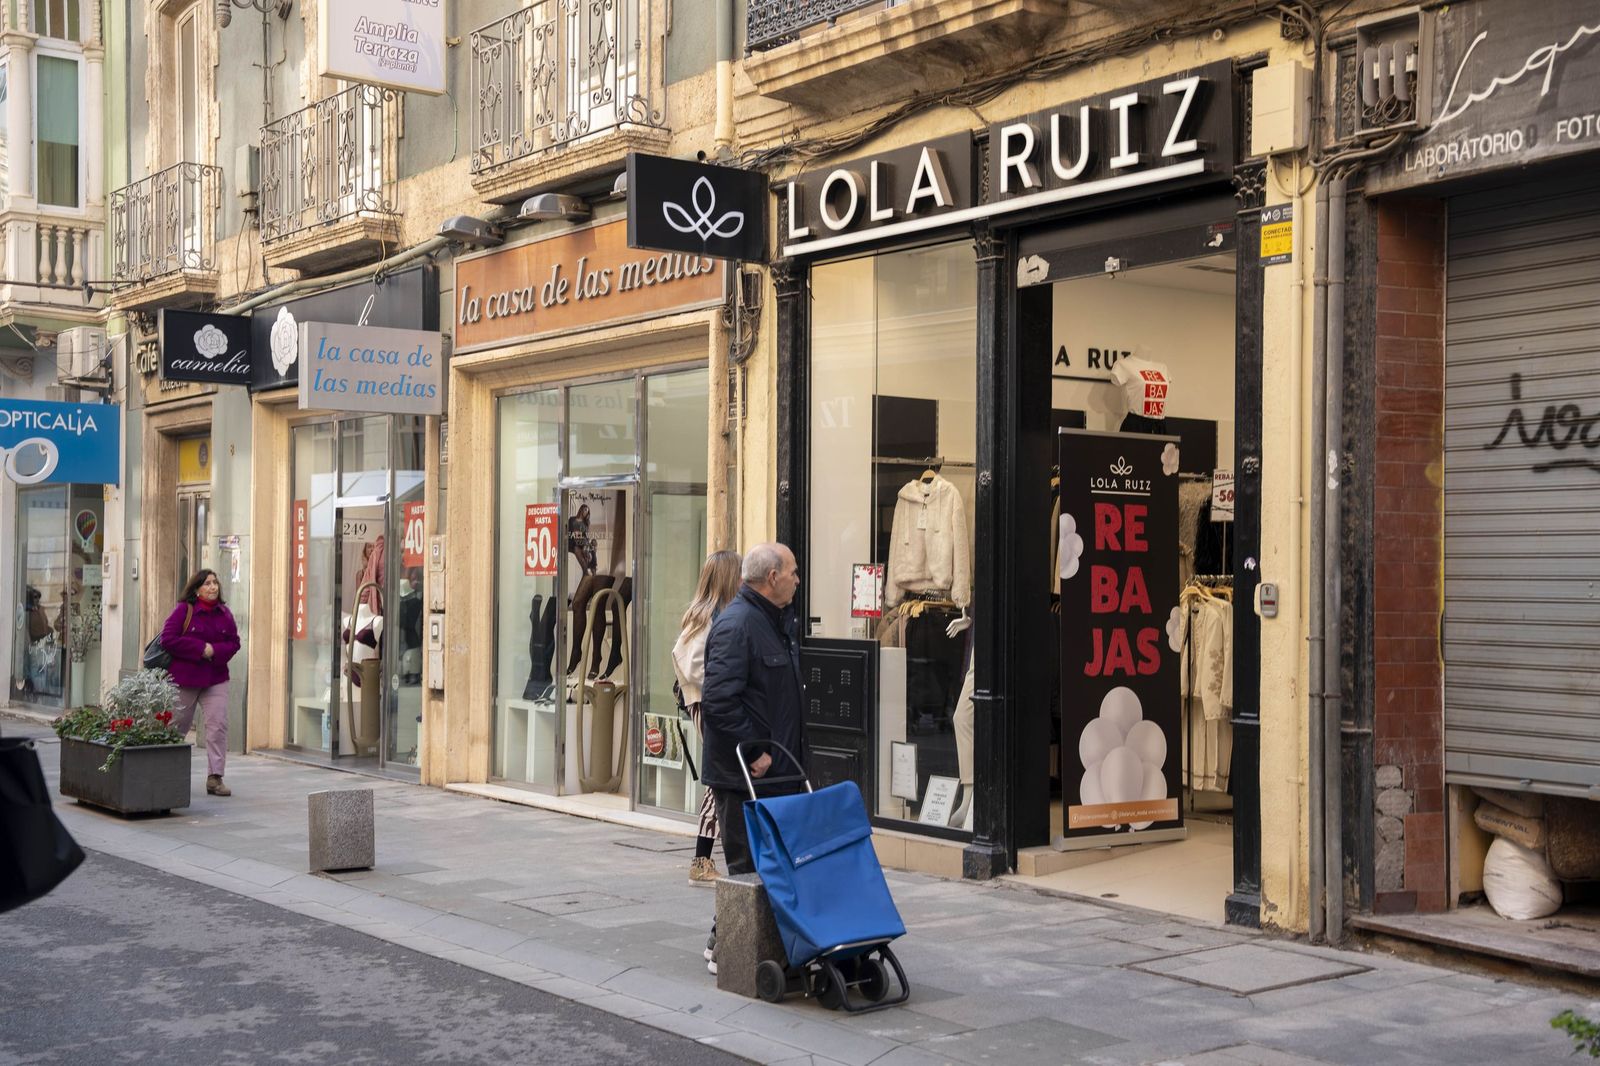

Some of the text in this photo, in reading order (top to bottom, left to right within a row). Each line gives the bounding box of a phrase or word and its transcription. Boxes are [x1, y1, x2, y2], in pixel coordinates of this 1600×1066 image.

[354, 15, 418, 45] Amplia
[354, 35, 420, 65] Terraza
[786, 76, 1201, 240] LOLA RUIZ
[1405, 129, 1524, 172] LABORATORIO
[459, 284, 483, 325] la
[485, 288, 537, 319] casa
[540, 262, 568, 306] de
[574, 255, 613, 300] las
[171, 350, 251, 374] camelia
[318, 336, 434, 368] la casa de
[314, 368, 438, 398] las medias
[1150, 384, 1164, 398] BA
[1146, 401, 1165, 417] JAS
[1090, 477, 1151, 491] LOLA RUIZ
[405, 518, 424, 555] 40
[534, 516, 552, 525] HASTA
[1094, 502, 1149, 552] RE
[296, 507, 305, 633] REBAJAS
[1090, 565, 1153, 614] BA
[1083, 627, 1162, 677] JAS
